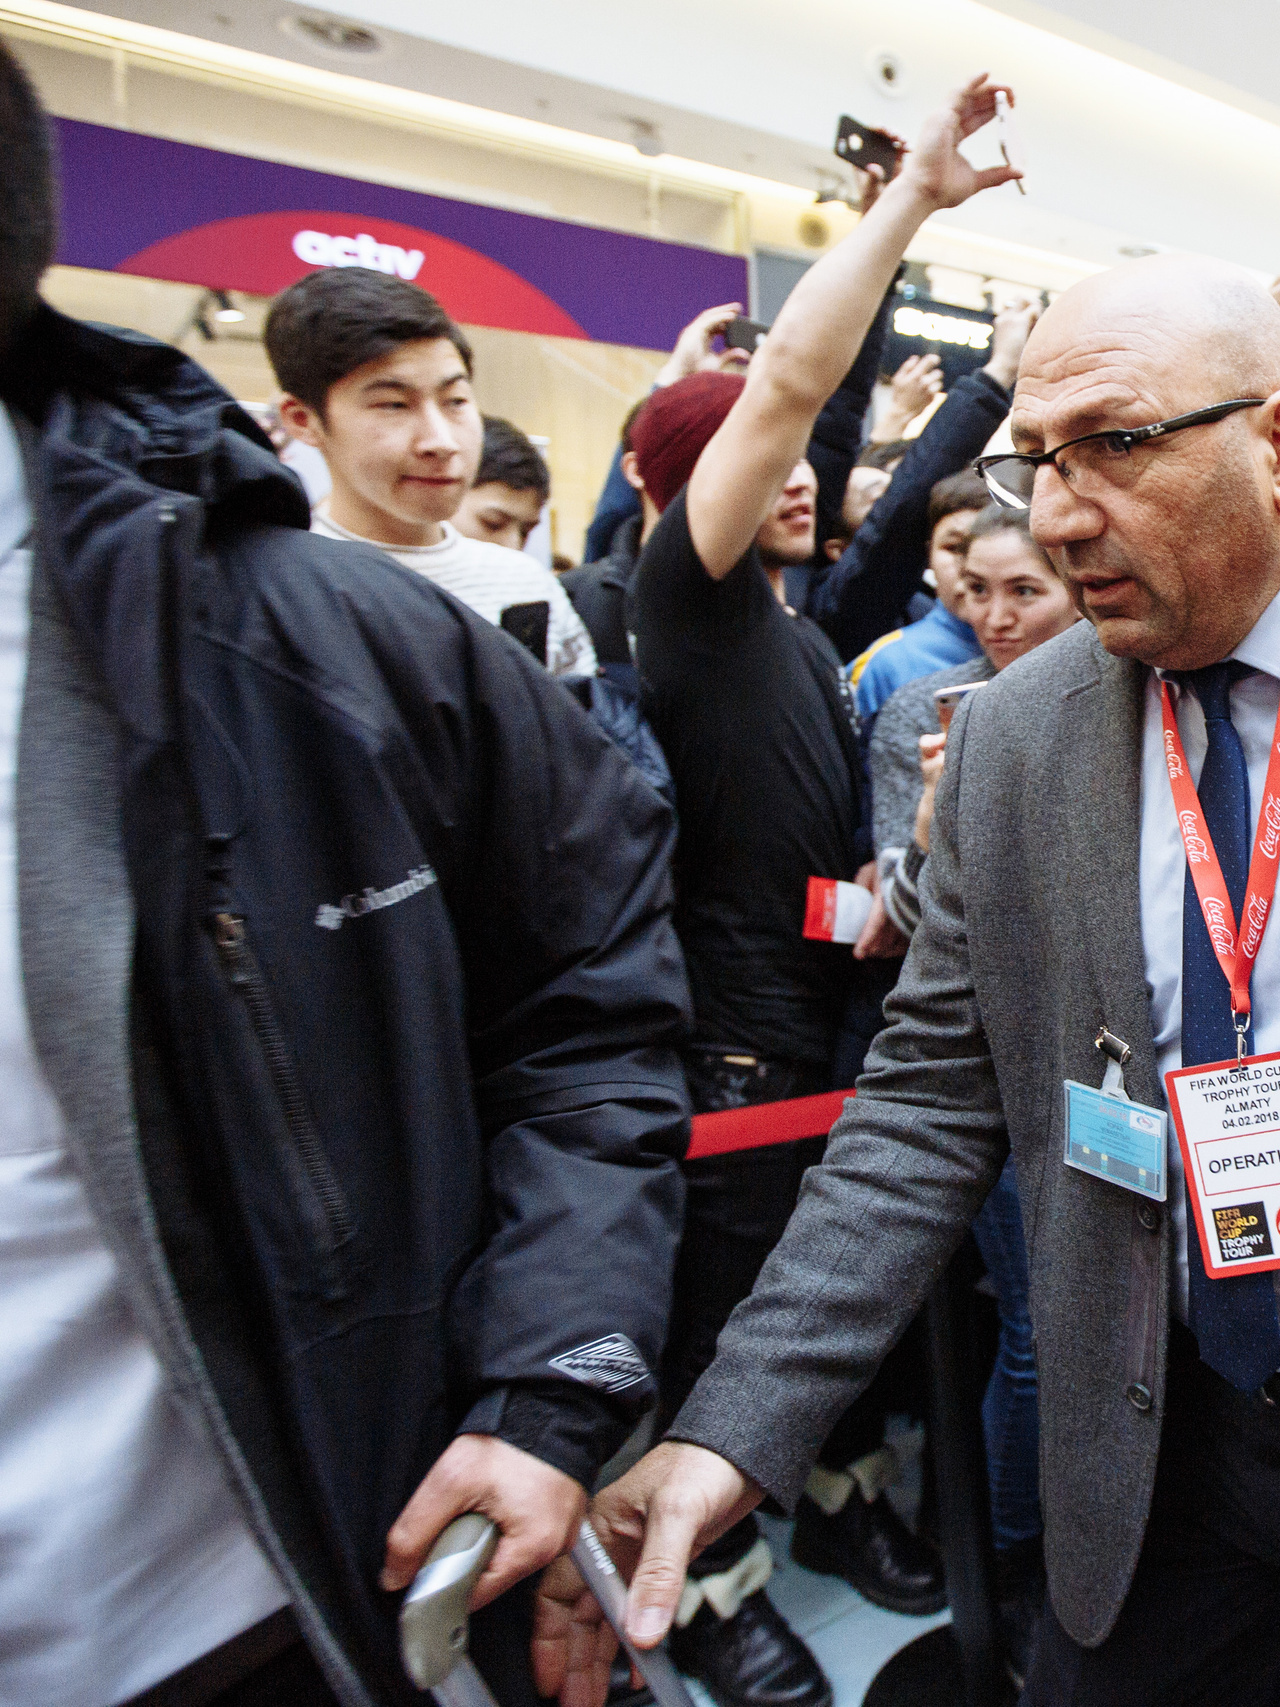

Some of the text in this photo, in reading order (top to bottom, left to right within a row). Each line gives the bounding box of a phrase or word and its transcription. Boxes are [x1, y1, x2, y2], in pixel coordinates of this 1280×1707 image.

[1189, 1078, 1216, 1091] FIFA
[1217, 1069, 1262, 1086] WORLD
[1202, 1086, 1250, 1103] TROPHY
[1224, 1097, 1271, 1114] ALMATY
[1222, 1111, 1280, 1129] 04.02.2018
[1214, 1208, 1241, 1220] FIFA
[1216, 1215, 1258, 1230] WORLD
[1220, 1233, 1265, 1249] TROPHY
[1222, 1246, 1254, 1259] TOUR
